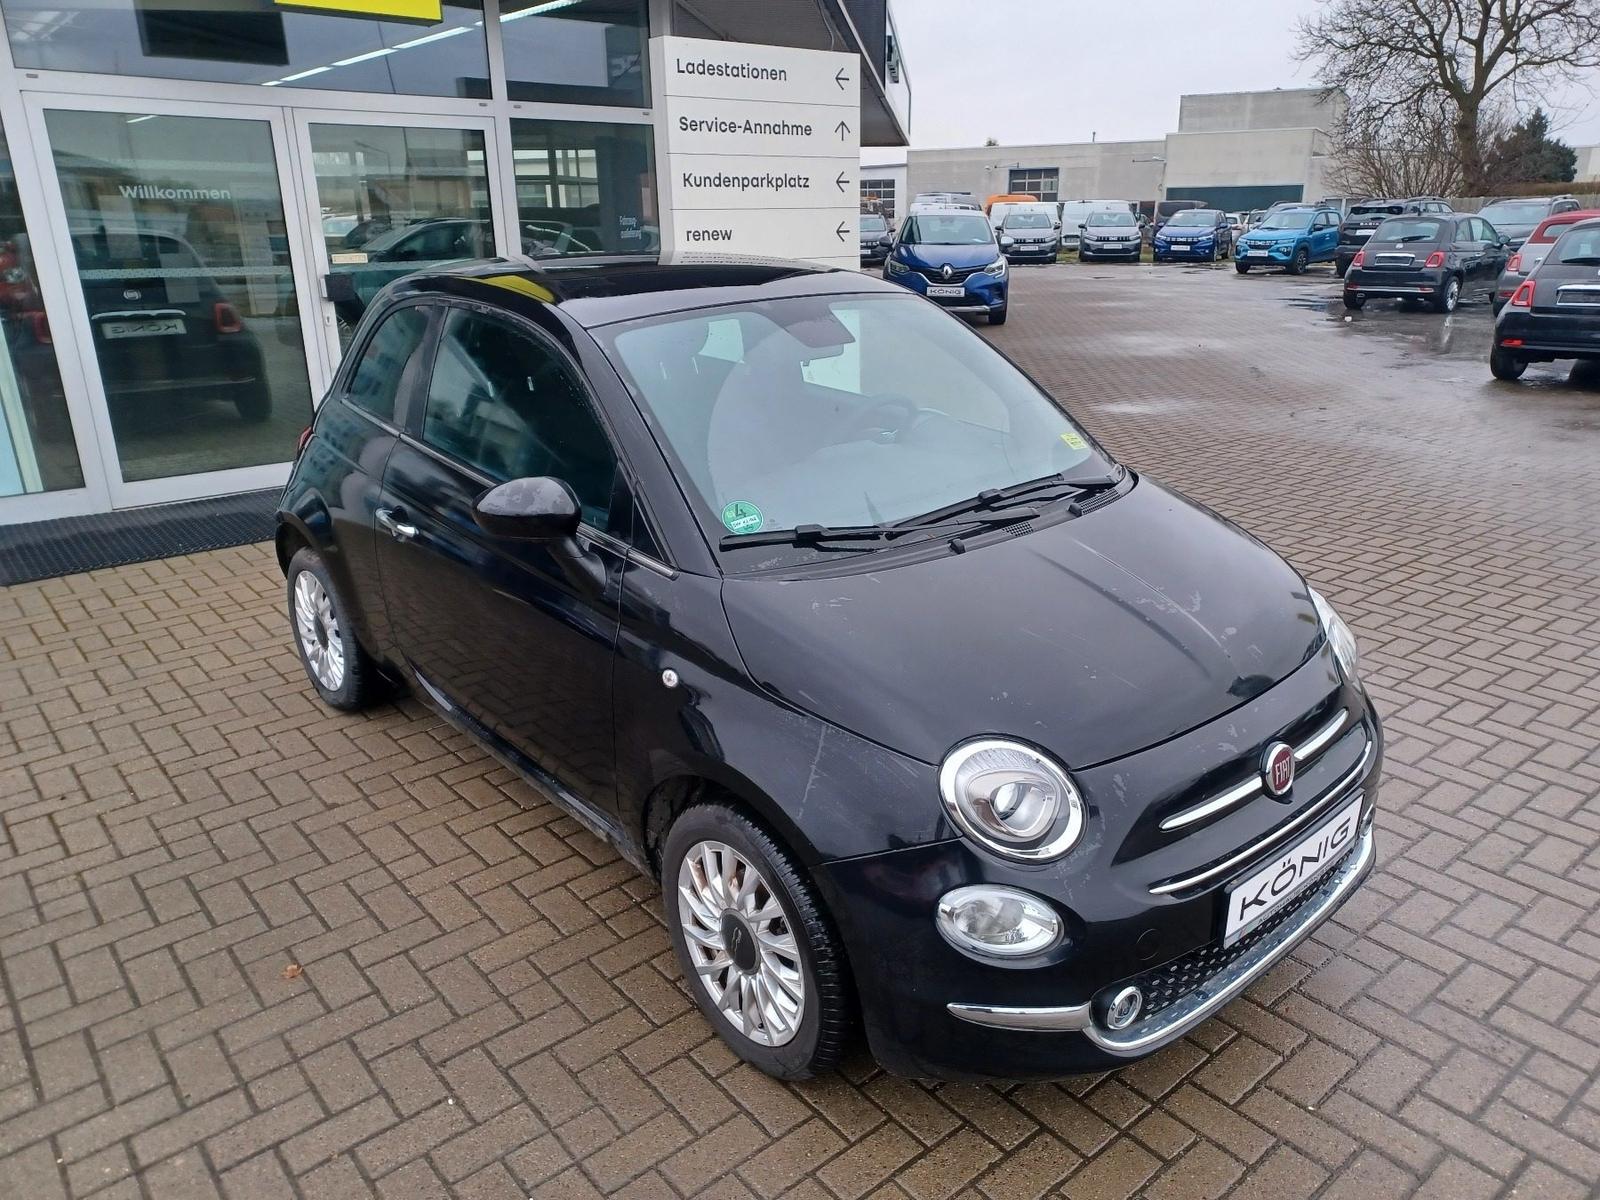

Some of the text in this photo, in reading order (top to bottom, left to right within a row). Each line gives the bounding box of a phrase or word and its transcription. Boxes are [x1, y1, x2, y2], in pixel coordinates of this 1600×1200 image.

[676, 58, 787, 82] Ladestationen
[679, 116, 812, 136] Service-Annahme
[683, 172, 810, 191] Kundenparkplatz
[118, 184, 232, 200] Willkommen
[686, 228, 733, 242] renew
[1275, 755, 1291, 786] FIAT
[1239, 817, 1351, 922] KÖNIG
